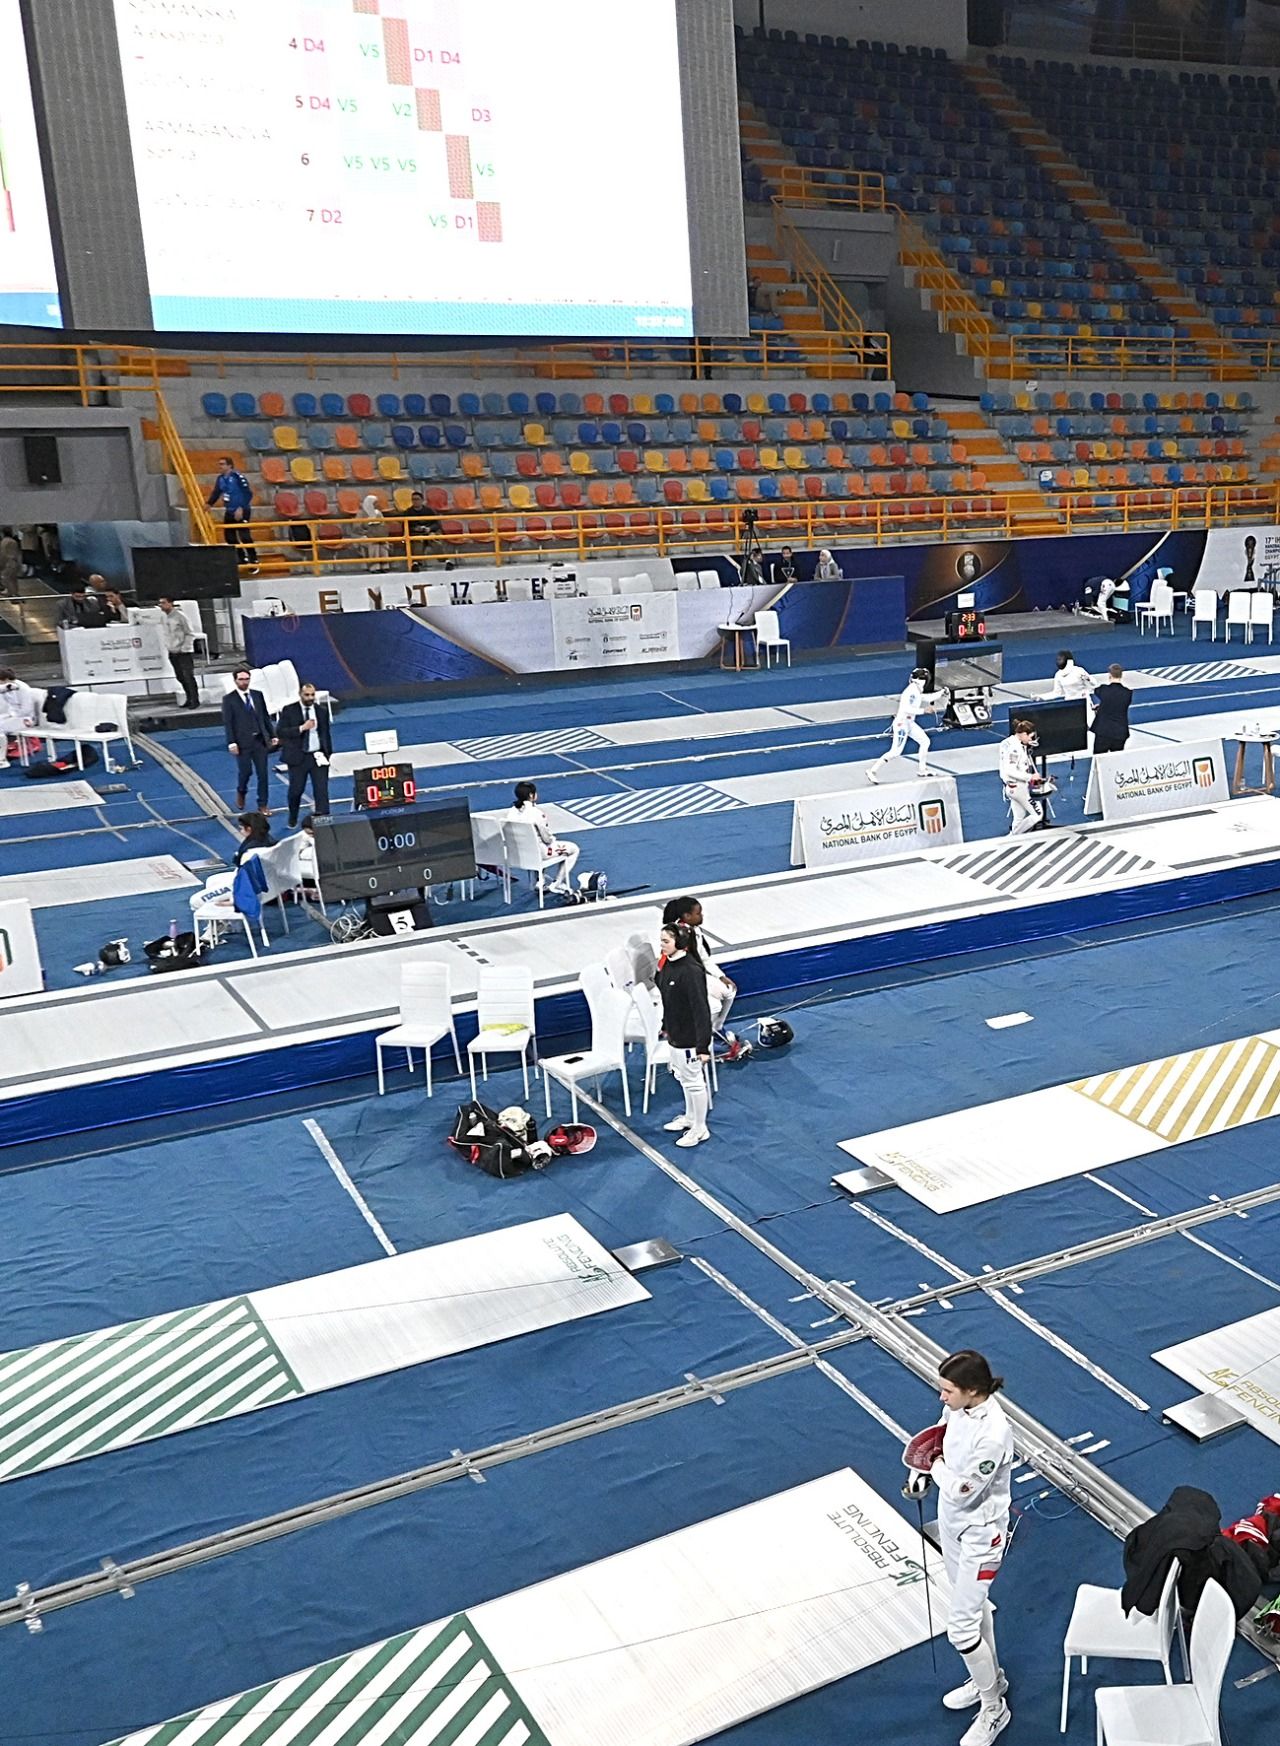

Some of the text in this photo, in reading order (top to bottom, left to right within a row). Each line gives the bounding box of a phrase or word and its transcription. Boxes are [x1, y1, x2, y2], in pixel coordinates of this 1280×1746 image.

[288, 37, 298, 50] 4
[303, 38, 325, 52] D4
[414, 48, 433, 63] D1
[440, 51, 461, 64] D4
[295, 95, 304, 108] 5
[309, 96, 331, 110] D4
[392, 102, 413, 117] V2
[471, 108, 492, 122] D3
[301, 153, 310, 166] 6
[306, 209, 315, 222] 7
[321, 209, 343, 224] D2
[455, 215, 473, 229] D1
[959, 624, 965, 636] 0
[978, 623, 984, 634] 0
[974, 705, 989, 720] 6
[372, 766, 396, 780] 0:00
[367, 785, 378, 802] 0
[403, 780, 414, 797] 0
[1117, 790, 1146, 800] NATIONAL
[1147, 787, 1163, 795] BANK
[1174, 781, 1192, 791] EGYPT
[377, 832, 415, 852] 0:00
[822, 827, 918, 849] NATIONAL BANK OF EGYPT
[368, 868, 432, 889] 0 0
[395, 917, 408, 930] 5
[827, 1512, 890, 1569] ABSOLUTE
[843, 1504, 908, 1562] FENCING
